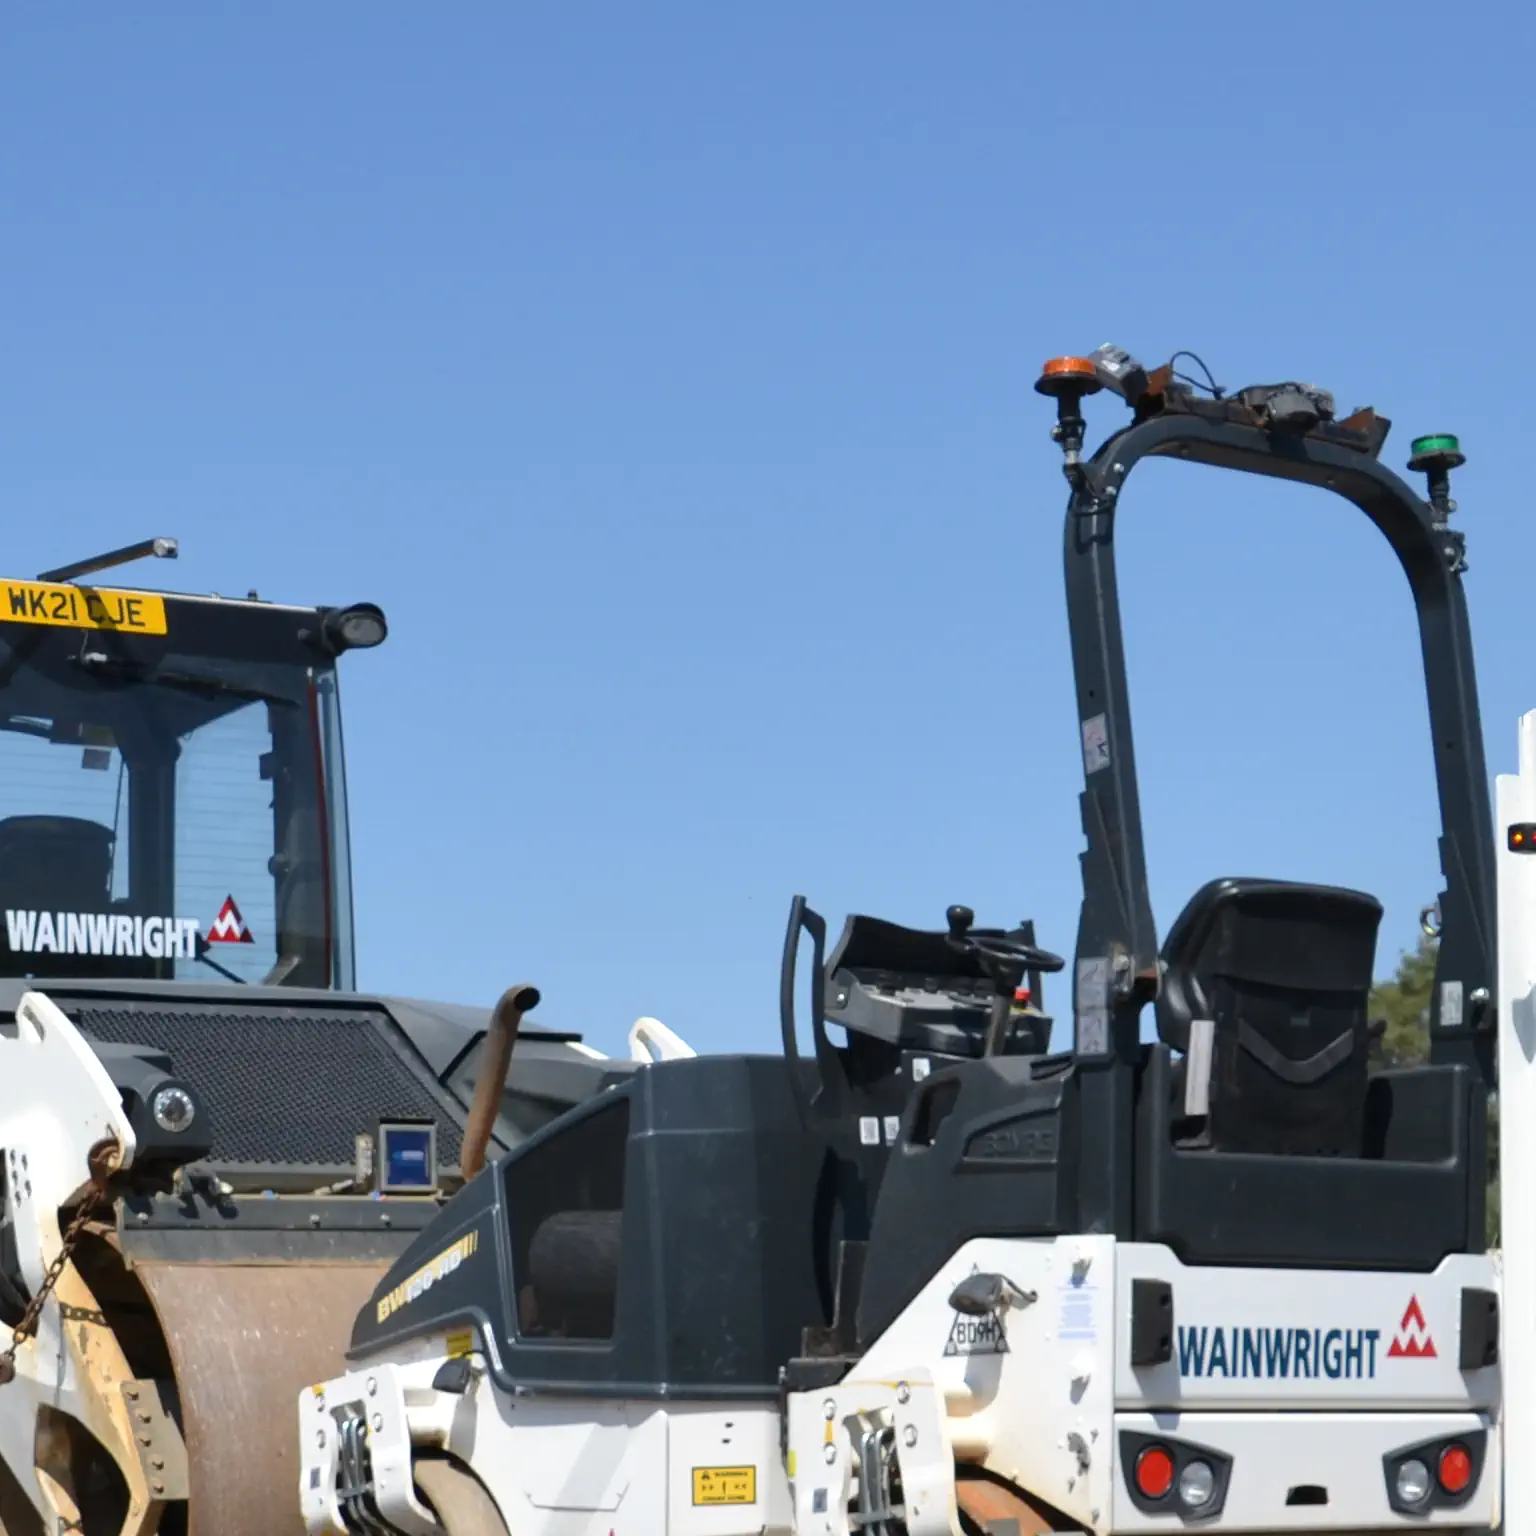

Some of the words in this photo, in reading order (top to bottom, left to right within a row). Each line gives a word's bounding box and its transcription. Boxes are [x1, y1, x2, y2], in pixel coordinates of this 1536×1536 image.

[8, 587, 78, 621] WK21
[86, 594, 146, 627] CJE
[5, 909, 200, 958] WAINWRIGHT
[1178, 1325, 1380, 1379] WAINWRIGHT
